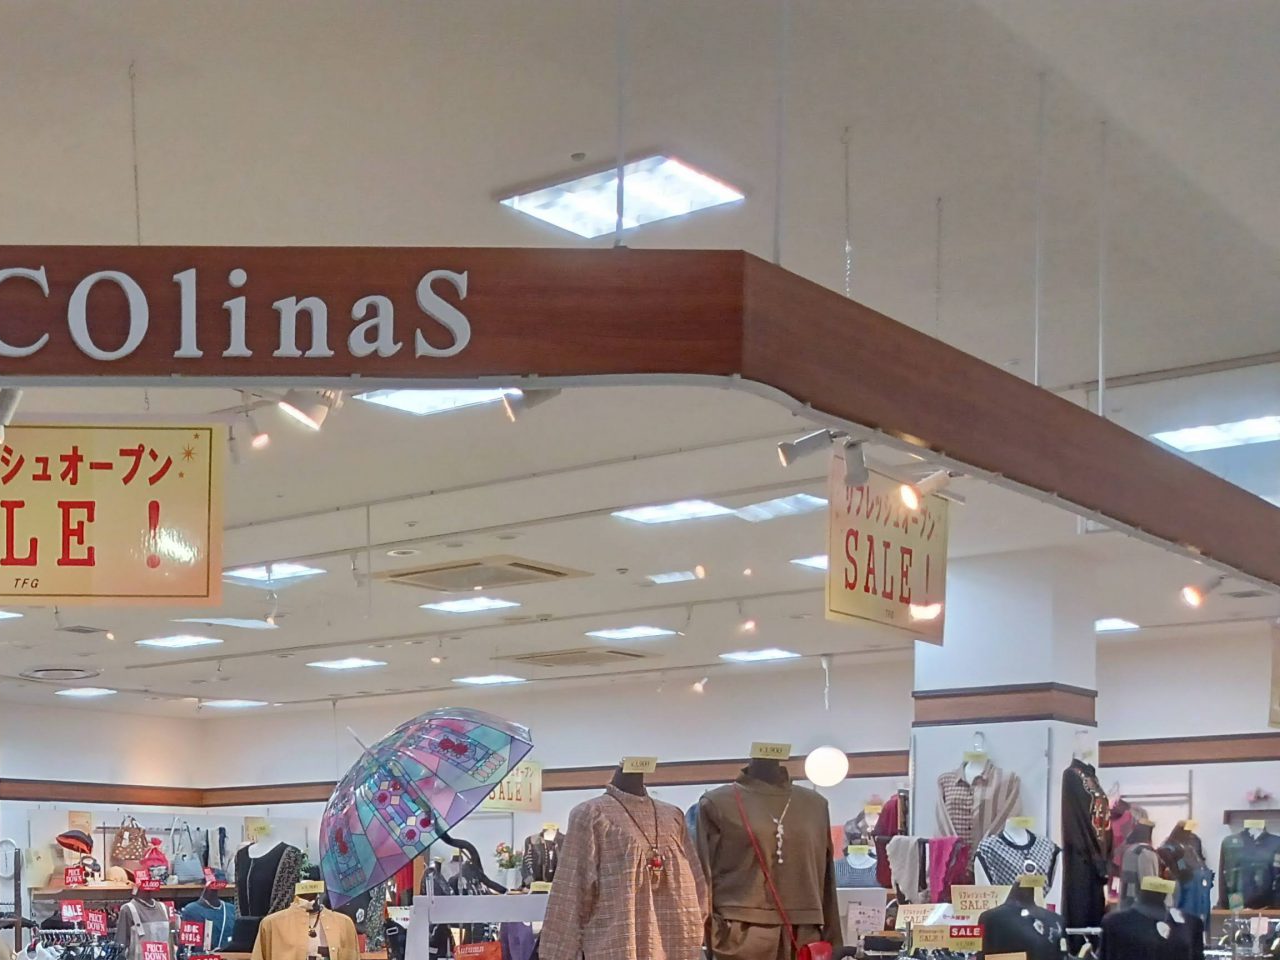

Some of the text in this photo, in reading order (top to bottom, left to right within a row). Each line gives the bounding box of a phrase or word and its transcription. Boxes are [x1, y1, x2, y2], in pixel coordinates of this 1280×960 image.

[13, 578, 40, 590] TFG
[951, 927, 981, 936] SALE
[146, 943, 165, 953] PRICE
